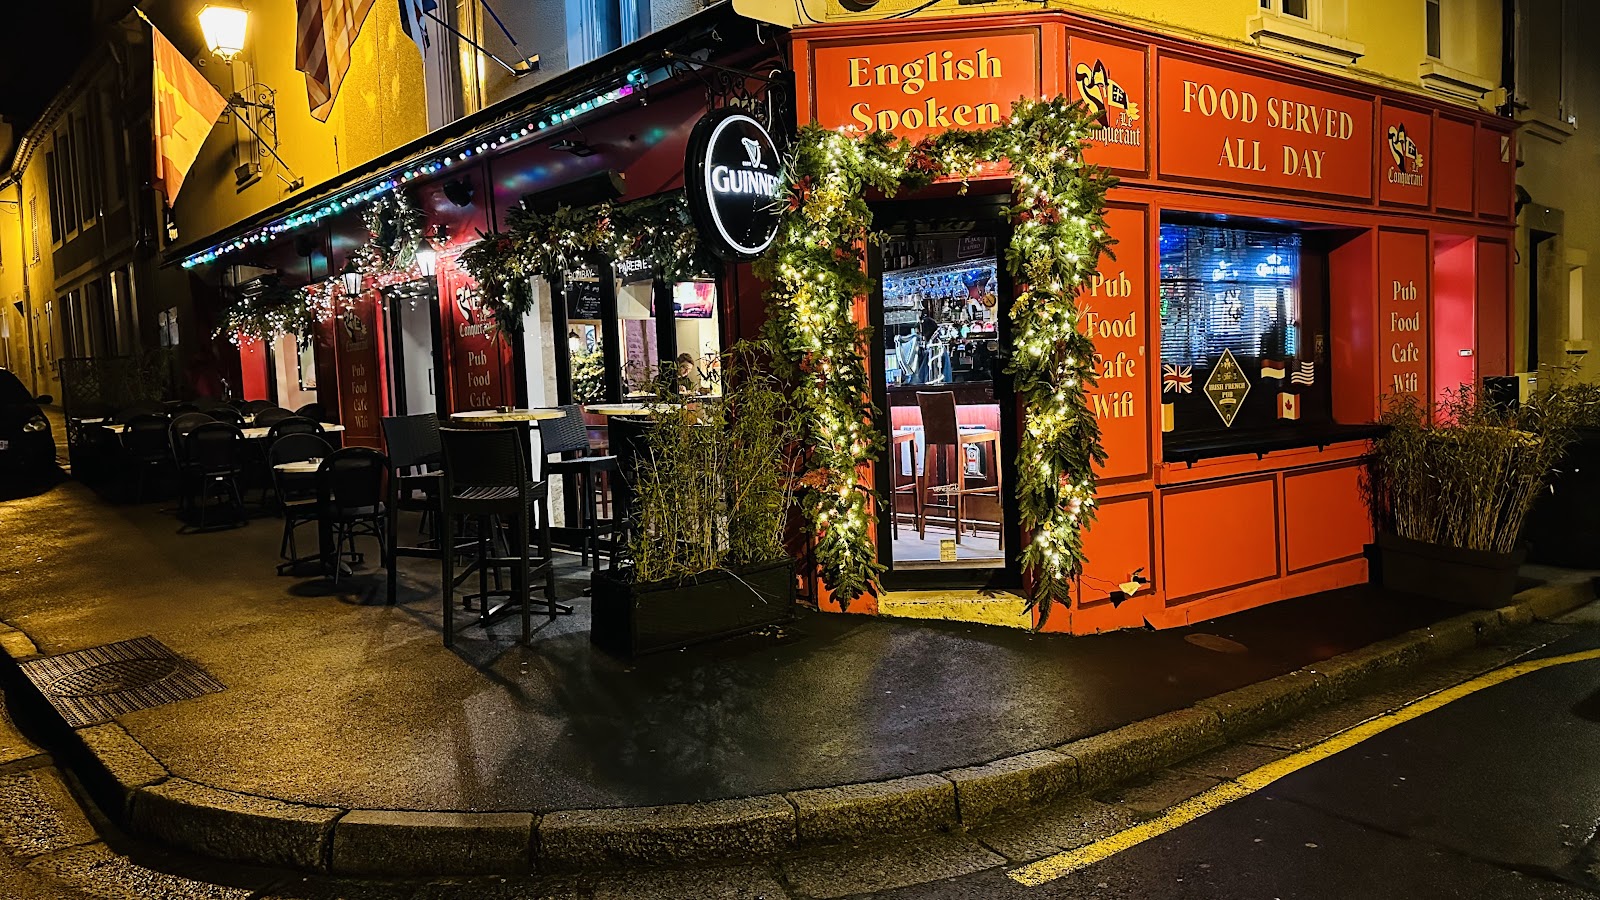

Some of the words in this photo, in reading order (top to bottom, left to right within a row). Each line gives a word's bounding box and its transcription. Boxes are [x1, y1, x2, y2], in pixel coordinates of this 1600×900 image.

[848, 47, 1003, 96] English
[850, 96, 1000, 135] Spoken
[1119, 112, 1133, 127] Le
[1182, 80, 1258, 124] FOOD
[1266, 96, 1354, 141] SERVED
[1082, 126, 1141, 147] onquerant
[1217, 136, 1267, 172] ALL
[1282, 145, 1326, 179] DAY
[711, 165, 782, 198] GUINNES
[1387, 166, 1424, 187] Conquerant
[1090, 270, 1132, 298] Pub
[1392, 280, 1417, 301] Pub
[1086, 311, 1137, 339] Food
[1390, 311, 1420, 332] Food
[468, 350, 487, 367] Pub
[1391, 341, 1419, 363] Cafe
[351, 364, 365, 377] Pub
[467, 370, 491, 388] Food
[351, 381, 368, 394] Food
[1208, 383, 1224, 391] IRISH
[1225, 382, 1246, 390] FRENCH
[1393, 372, 1418, 394] Wifi
[353, 398, 368, 411] Cafe
[469, 391, 491, 408] Cafe
[1091, 391, 1135, 420] Wifi
[1221, 391, 1234, 399] PUB
